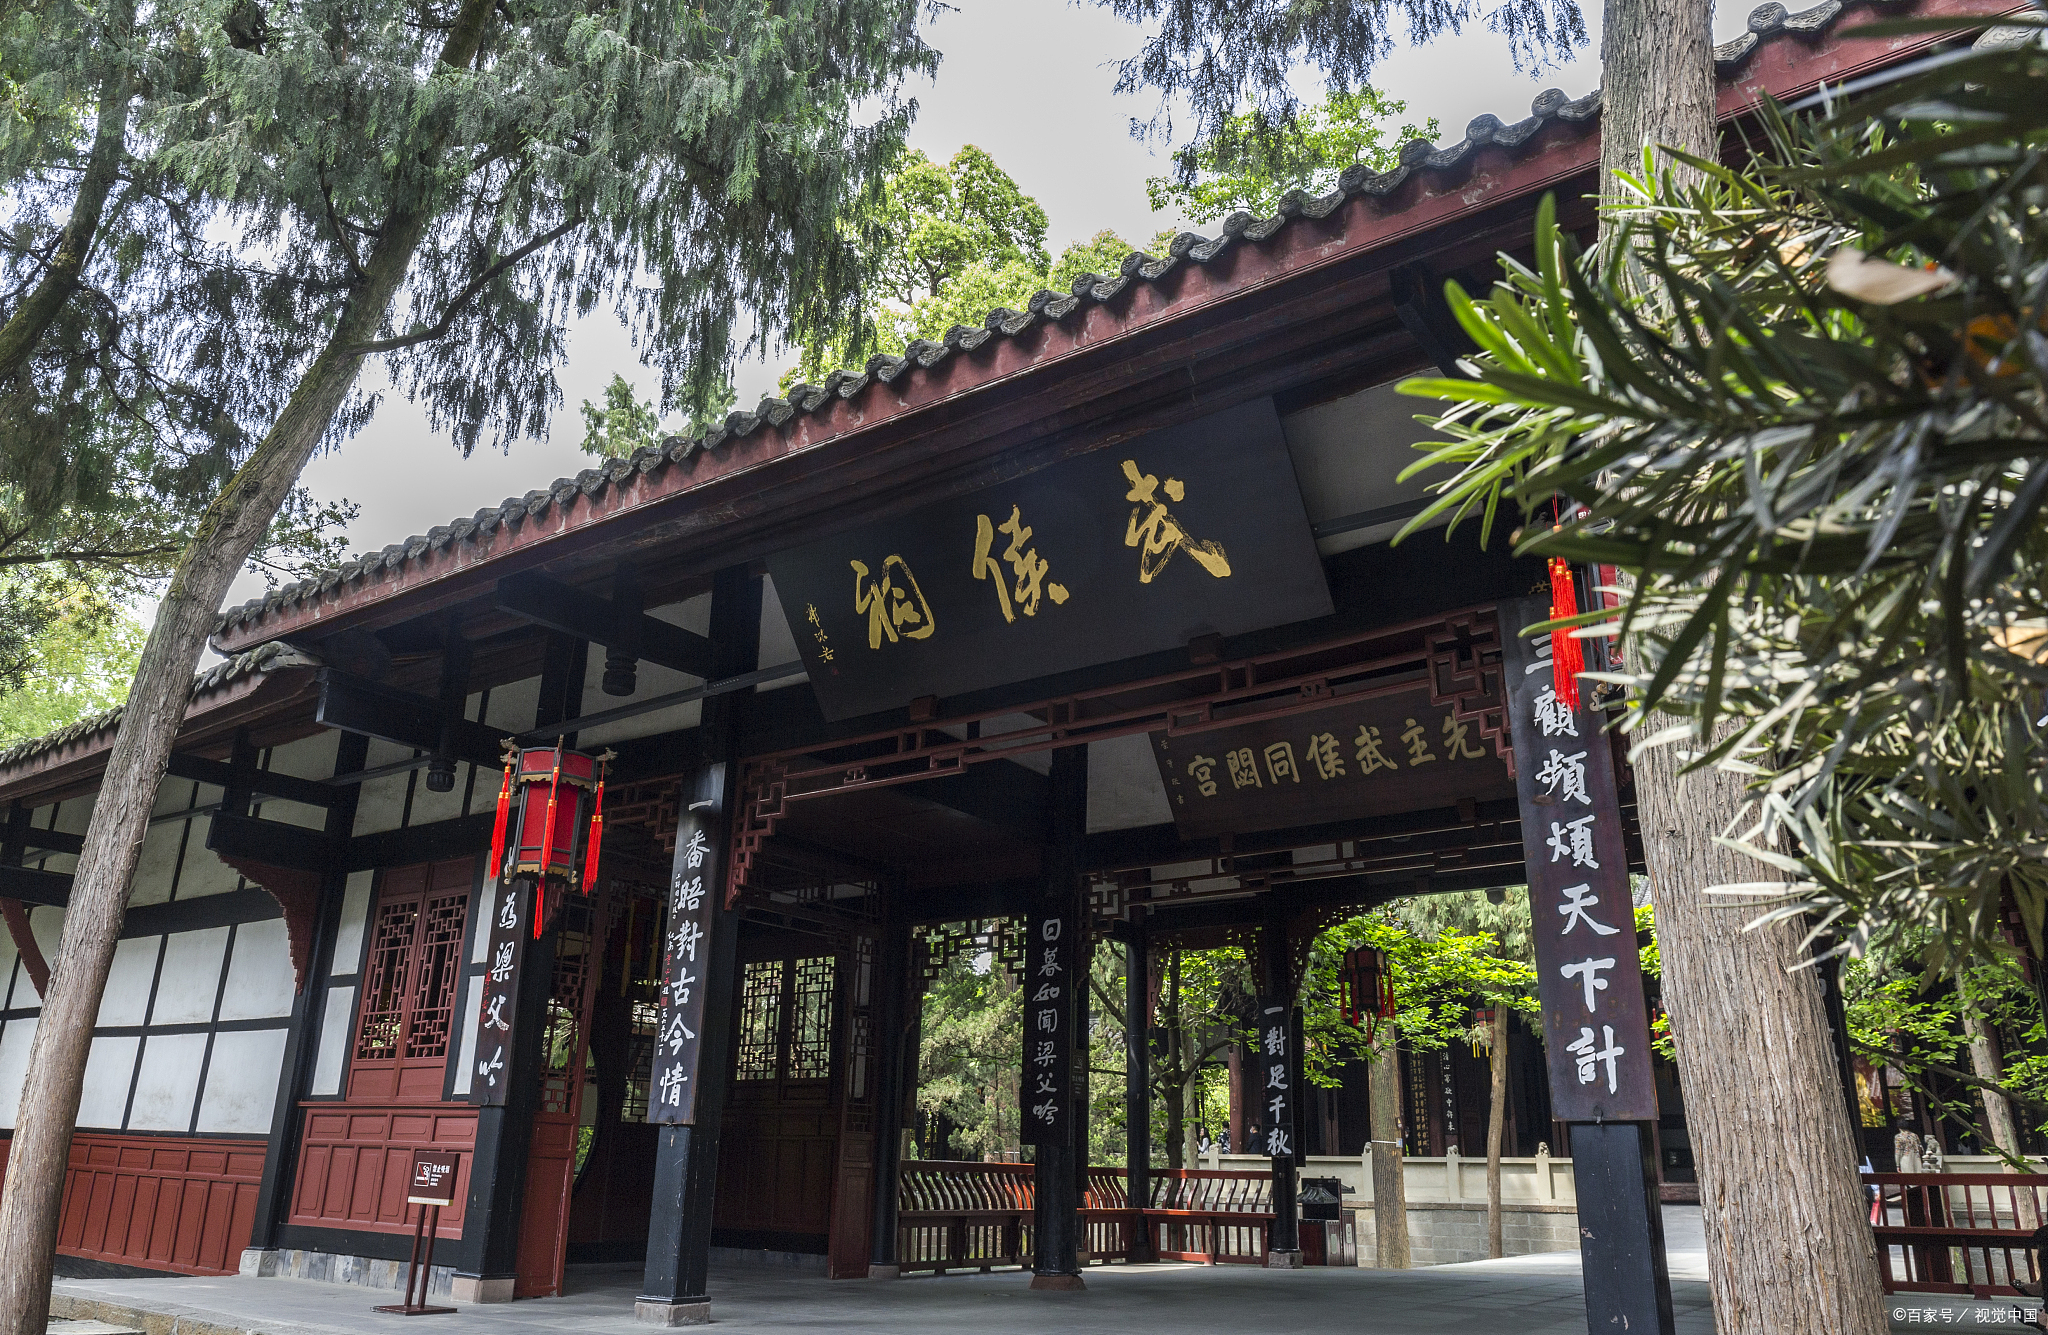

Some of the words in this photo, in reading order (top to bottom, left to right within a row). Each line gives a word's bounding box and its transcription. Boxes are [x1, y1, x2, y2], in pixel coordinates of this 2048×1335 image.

[1264, 1006, 1294, 1157] 一對足千秋
